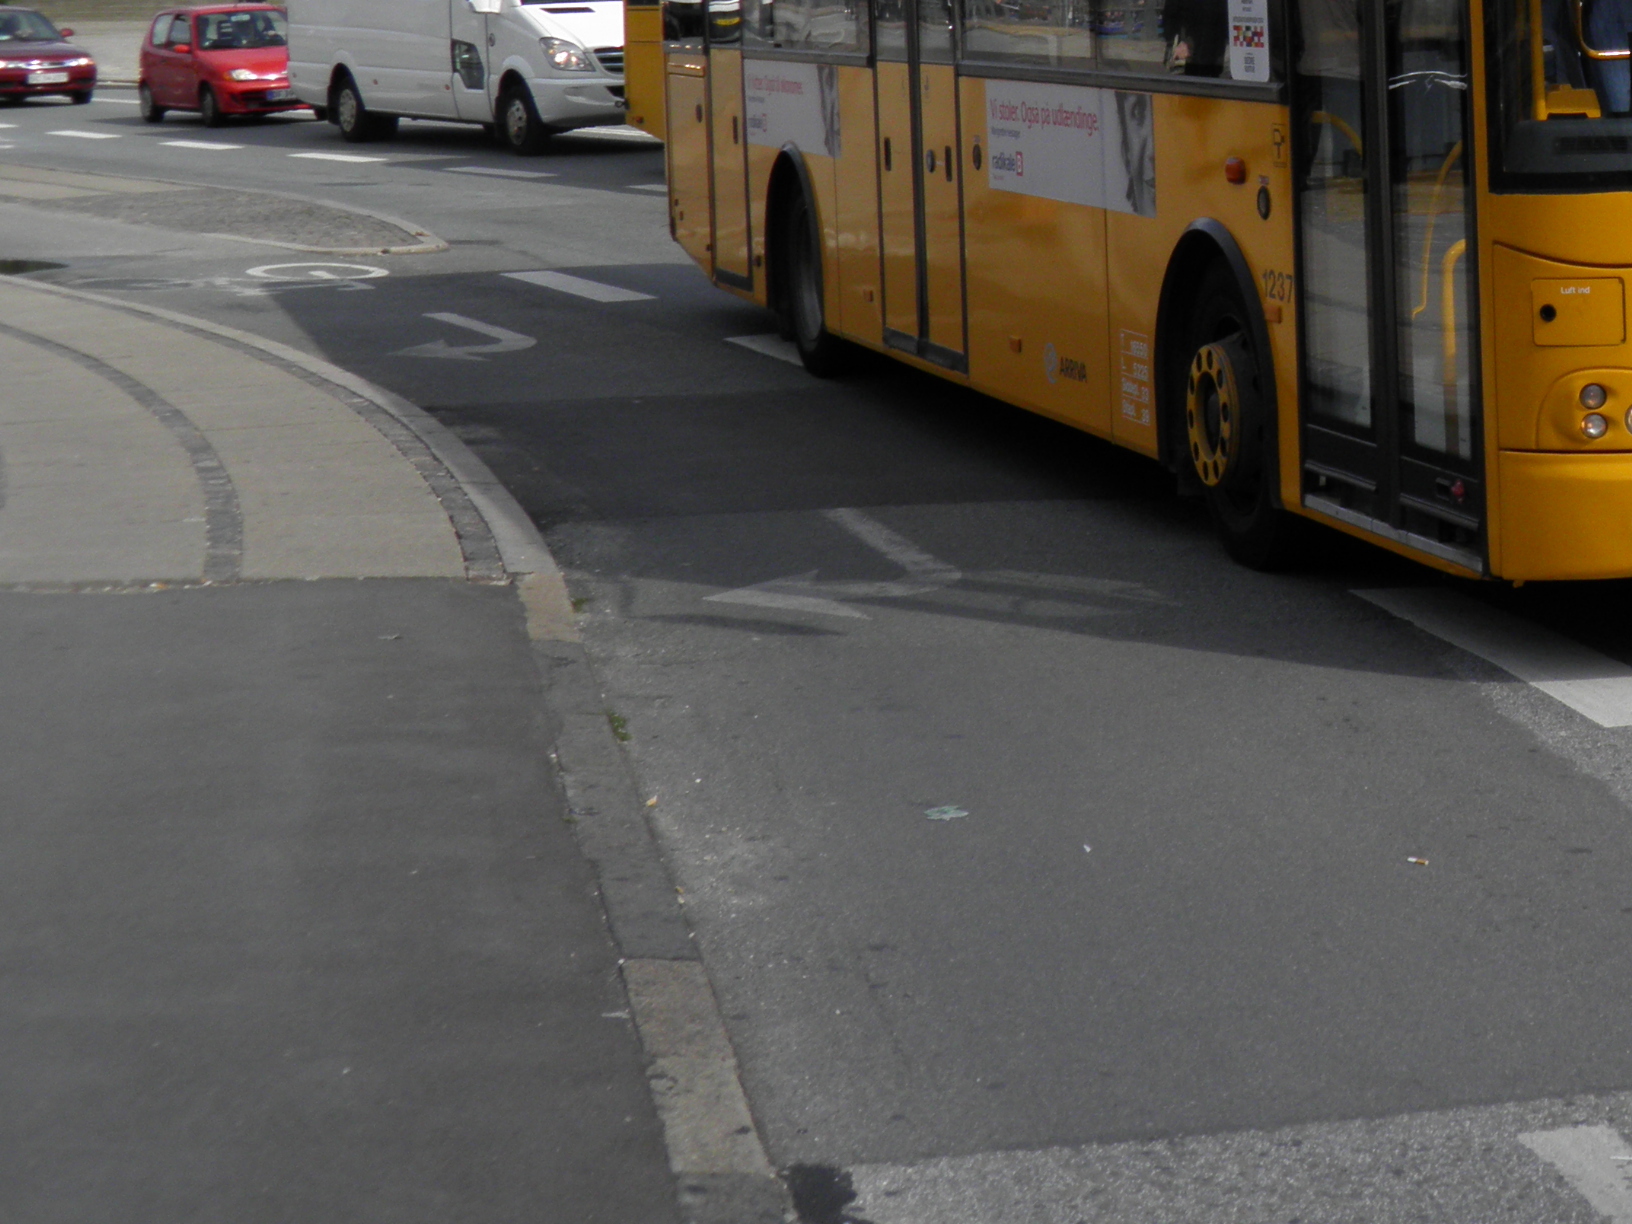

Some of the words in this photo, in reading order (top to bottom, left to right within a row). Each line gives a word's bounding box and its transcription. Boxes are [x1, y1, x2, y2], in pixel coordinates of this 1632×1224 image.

[1262, 269, 1293, 303] 1237
[1578, 286, 1590, 294] ind
[1060, 356, 1087, 383] ARRIVA
